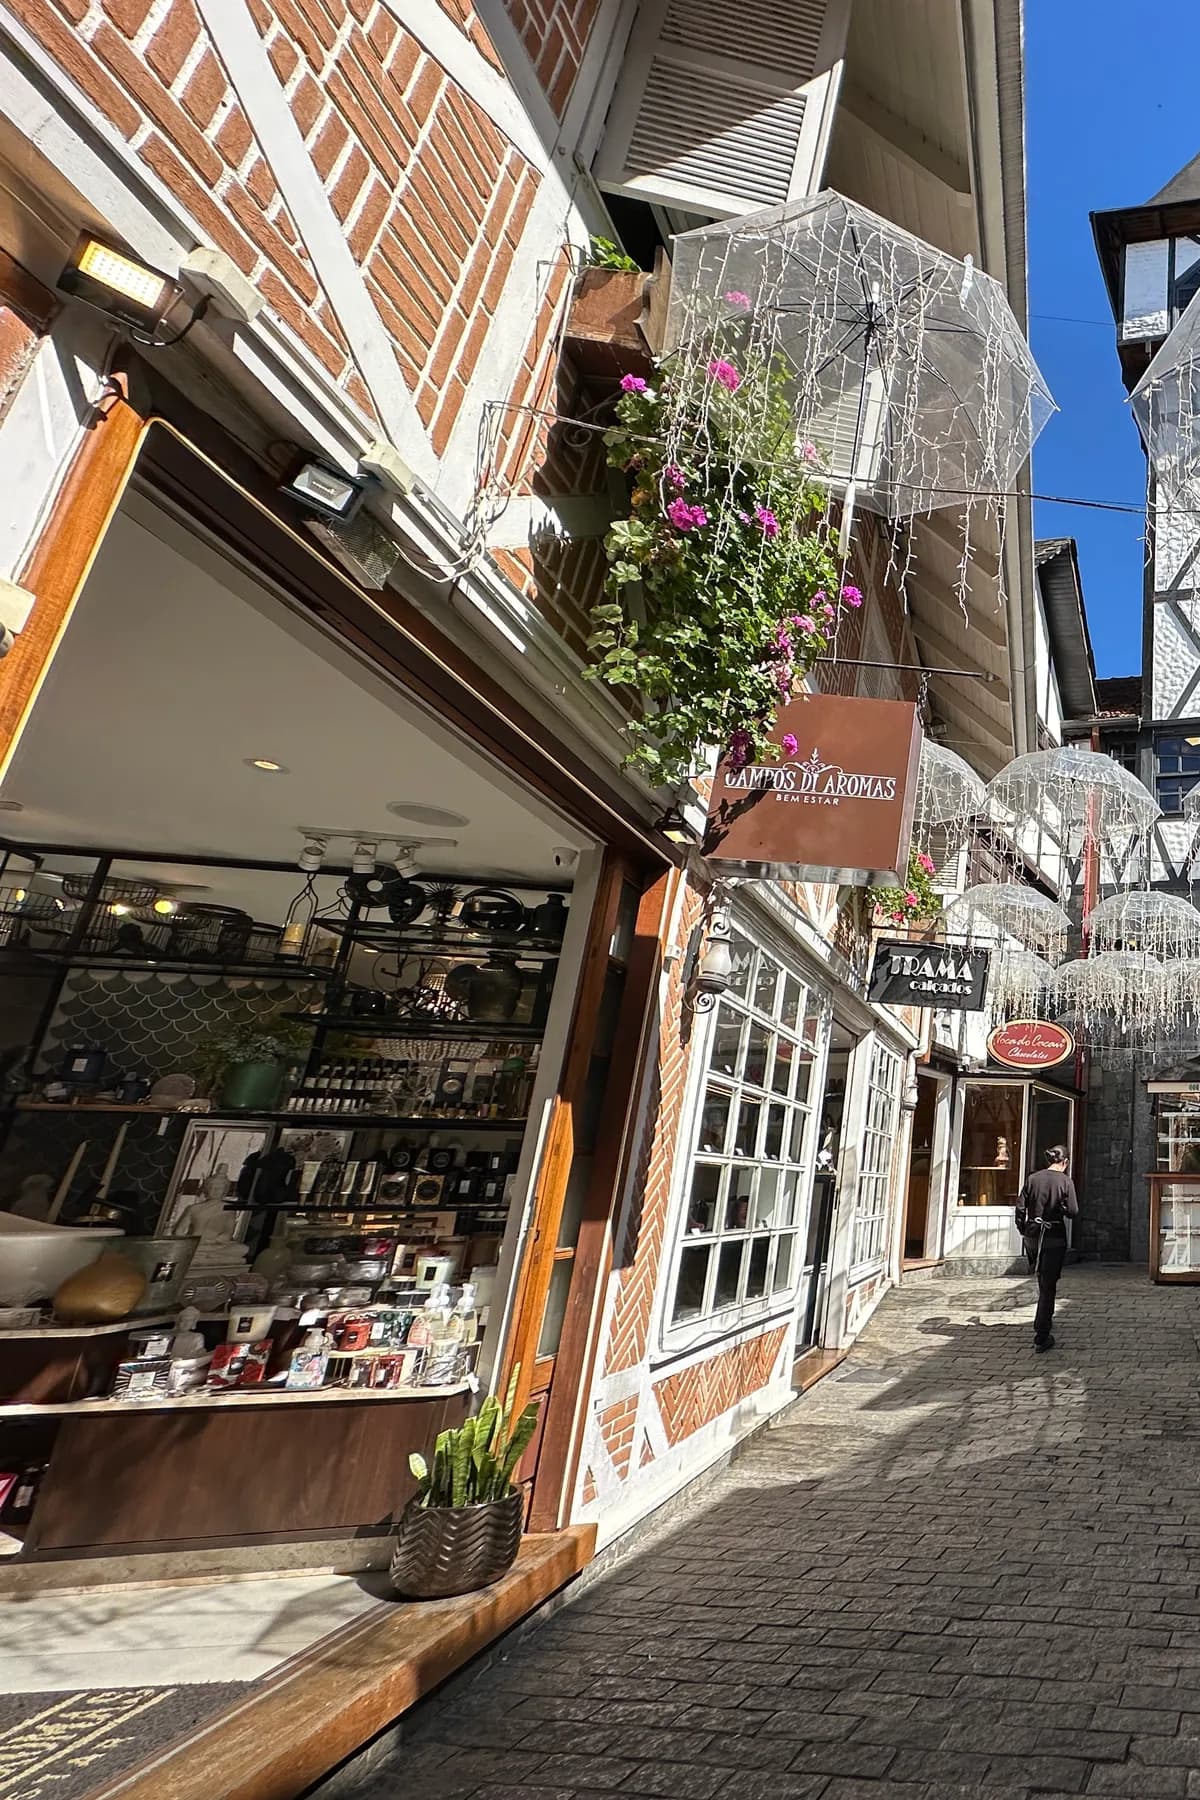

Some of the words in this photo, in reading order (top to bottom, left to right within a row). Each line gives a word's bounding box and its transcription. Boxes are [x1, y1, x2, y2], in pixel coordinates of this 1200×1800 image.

[725, 768, 796, 791] CAMPOS
[801, 772, 819, 792] DI
[824, 774, 896, 799] AROMAS
[776, 794, 800, 803] BEM
[803, 795, 839, 806] ESTAR
[889, 954, 973, 981] TRAMA
[909, 980, 973, 995] calçados
[1008, 1046, 1049, 1060] Chocolates
